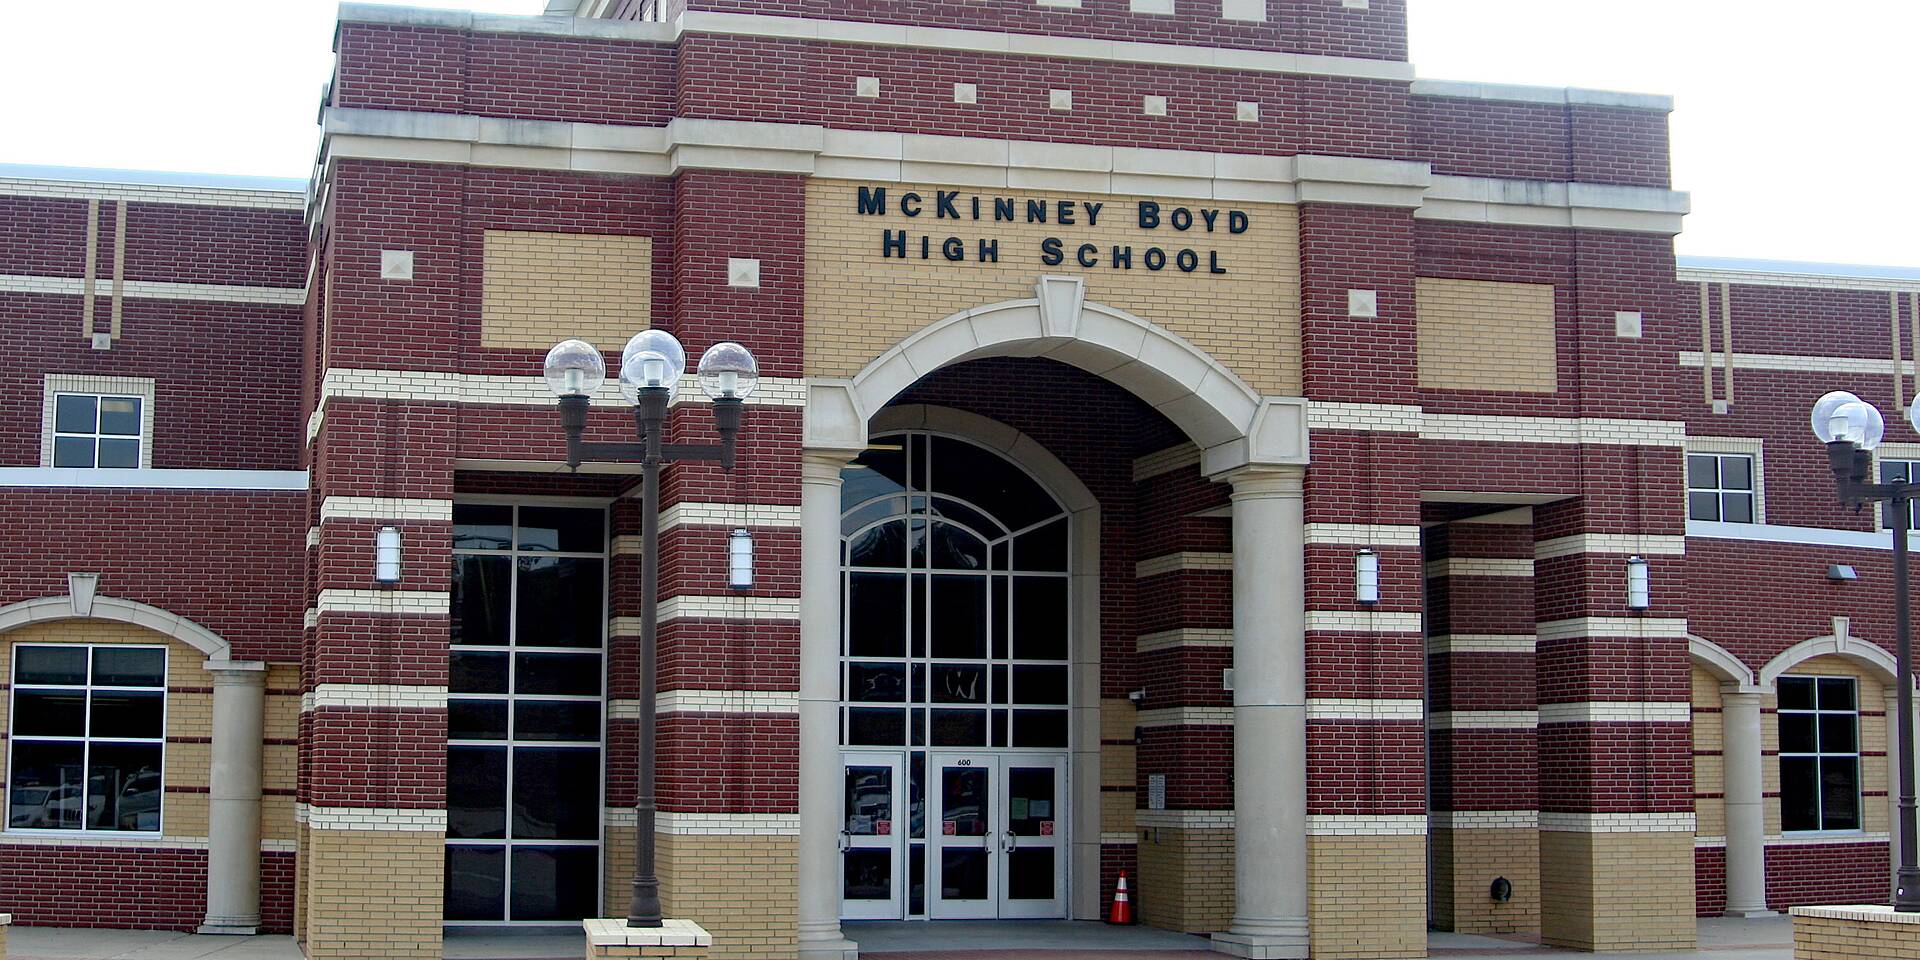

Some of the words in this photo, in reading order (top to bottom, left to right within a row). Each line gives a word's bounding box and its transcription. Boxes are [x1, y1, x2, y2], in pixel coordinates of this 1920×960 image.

[1138, 200, 1250, 235] BOYD
[882, 229, 998, 264] HIGH
[1041, 237, 1227, 275] SCHOOL
[957, 758, 972, 767] 600
